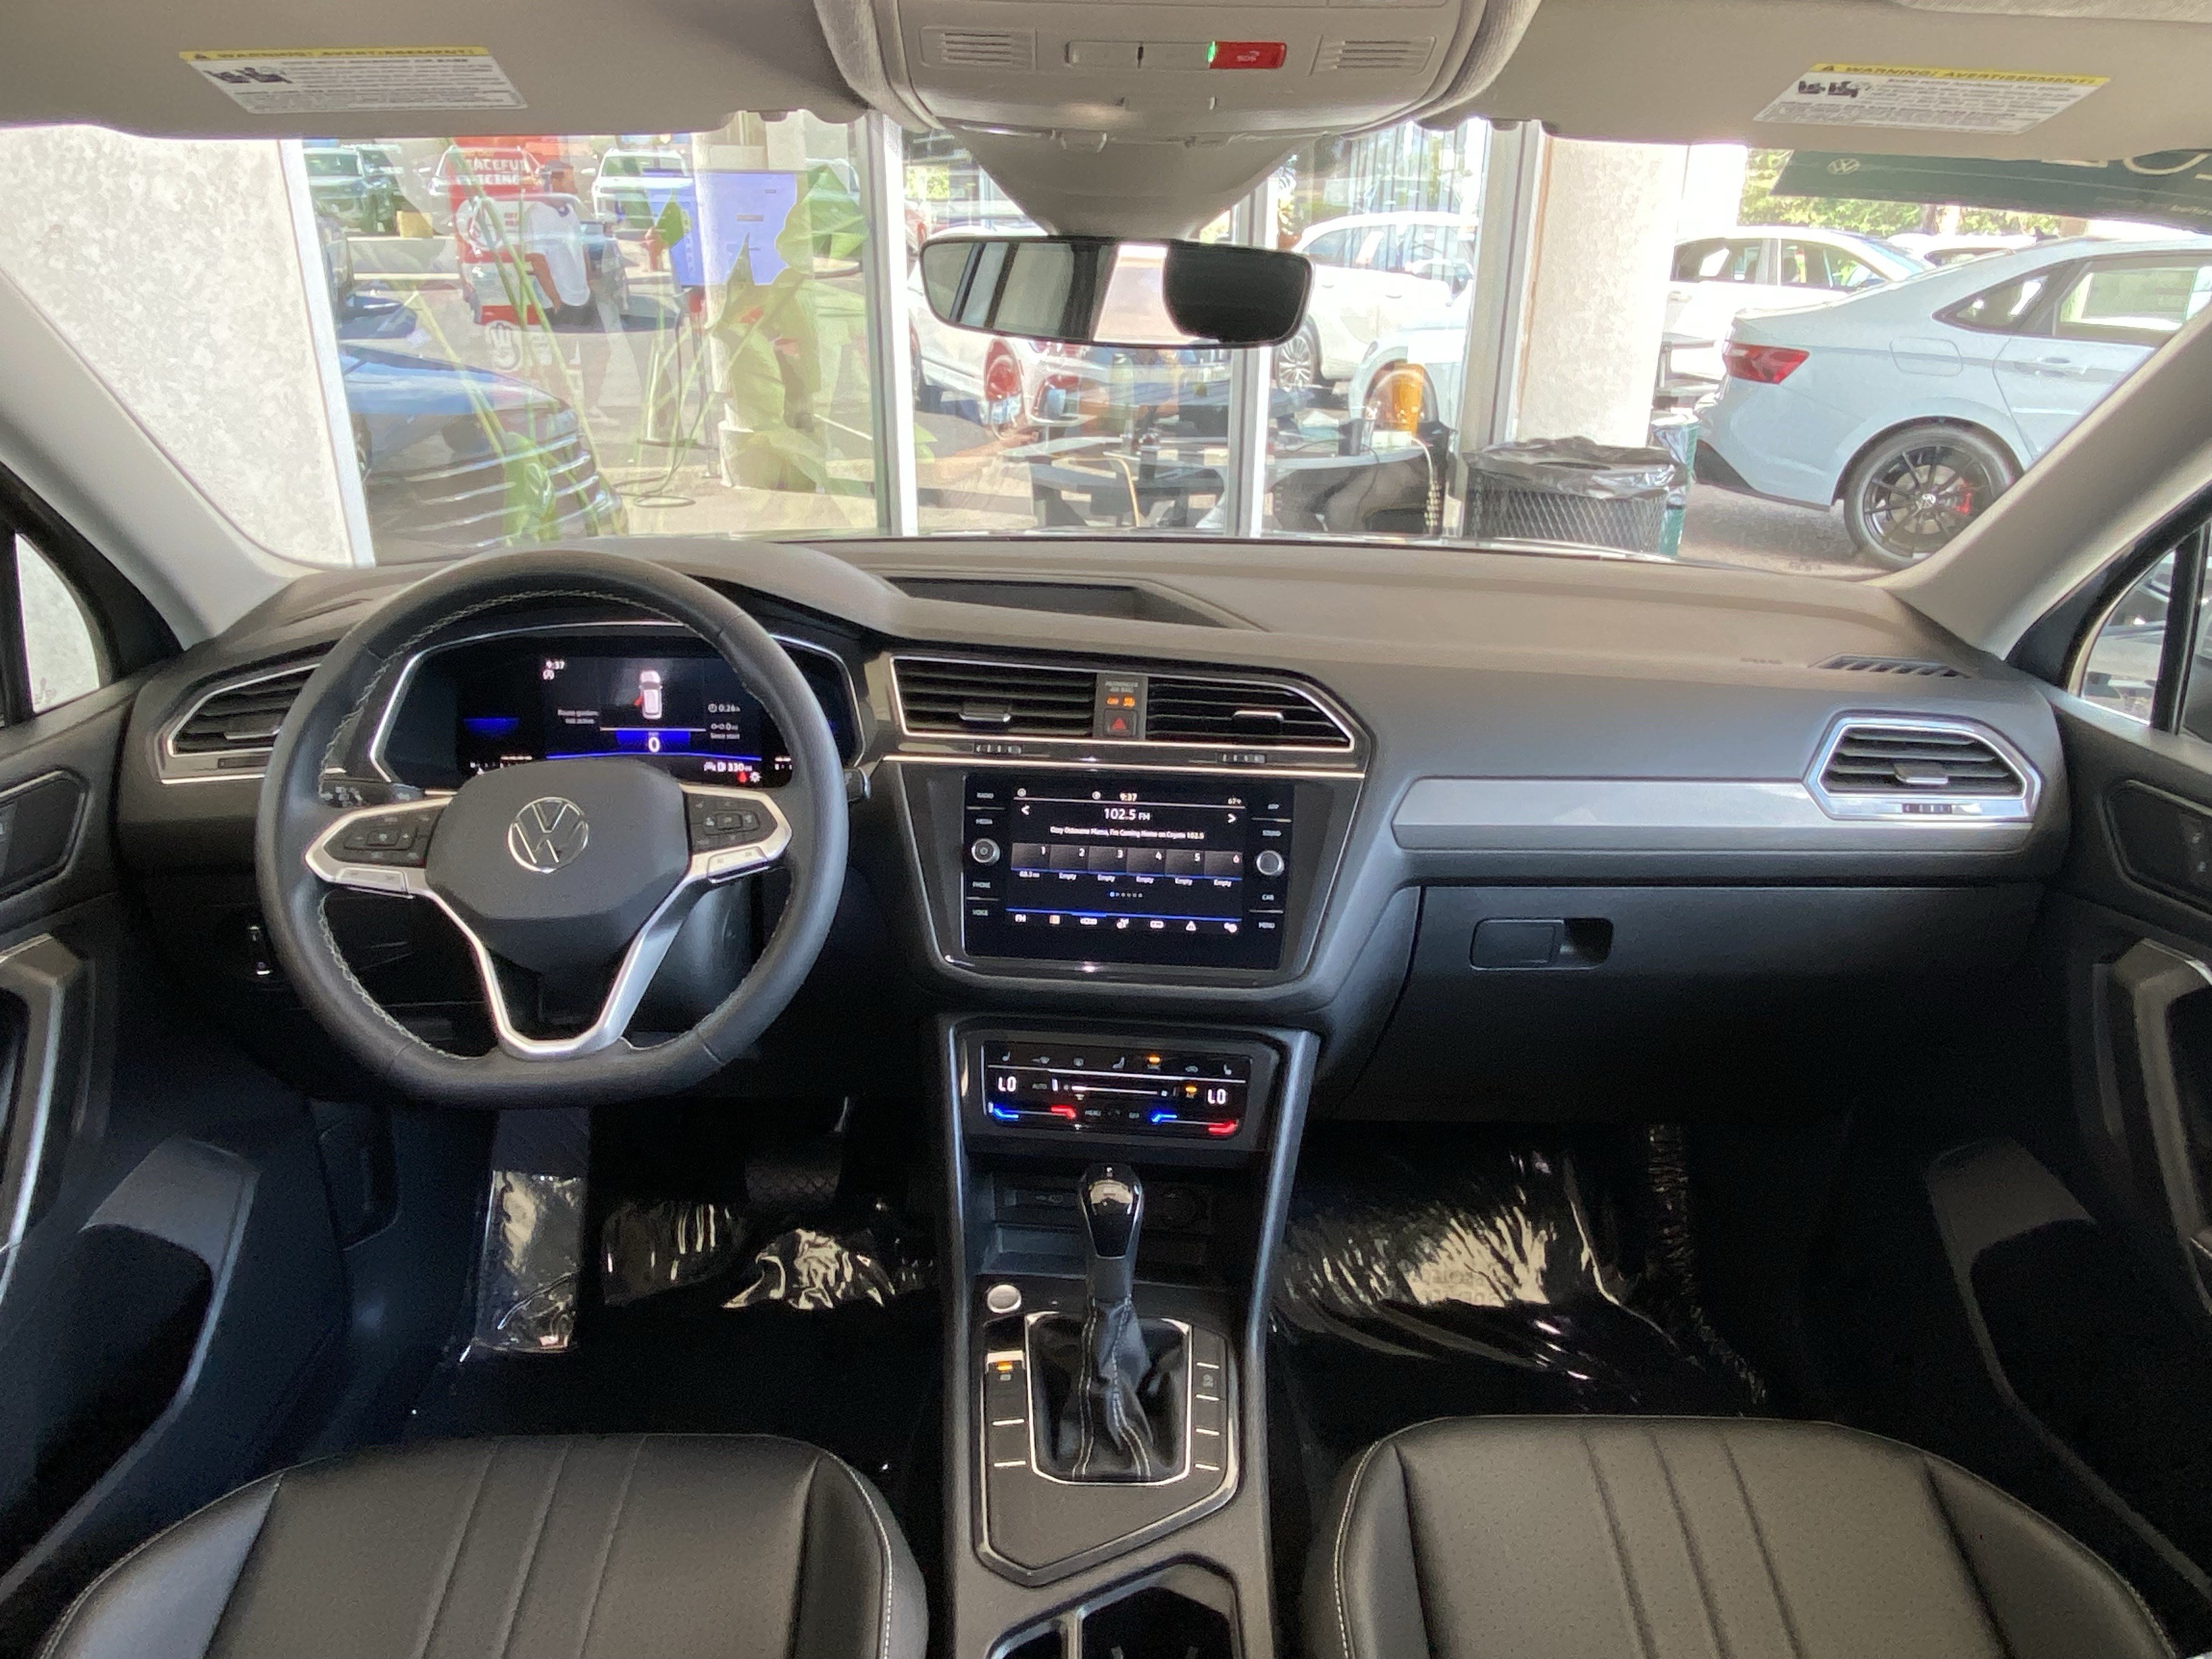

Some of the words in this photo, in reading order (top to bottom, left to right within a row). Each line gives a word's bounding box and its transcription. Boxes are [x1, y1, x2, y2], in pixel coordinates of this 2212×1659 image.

[649, 737, 660, 752] 0
[728, 763, 744, 772] 330
[1119, 793, 1138, 802] 9:37
[1104, 808, 1136, 821] 102.5
[1041, 847, 1046, 855] 1
[1079, 848, 1086, 857] 2
[1117, 849, 1123, 859] 3
[1155, 851, 1163, 860] 4
[1194, 853, 1200, 862] 5
[997, 1076, 1017, 1092] LO
[1207, 1089, 1226, 1104] LO
